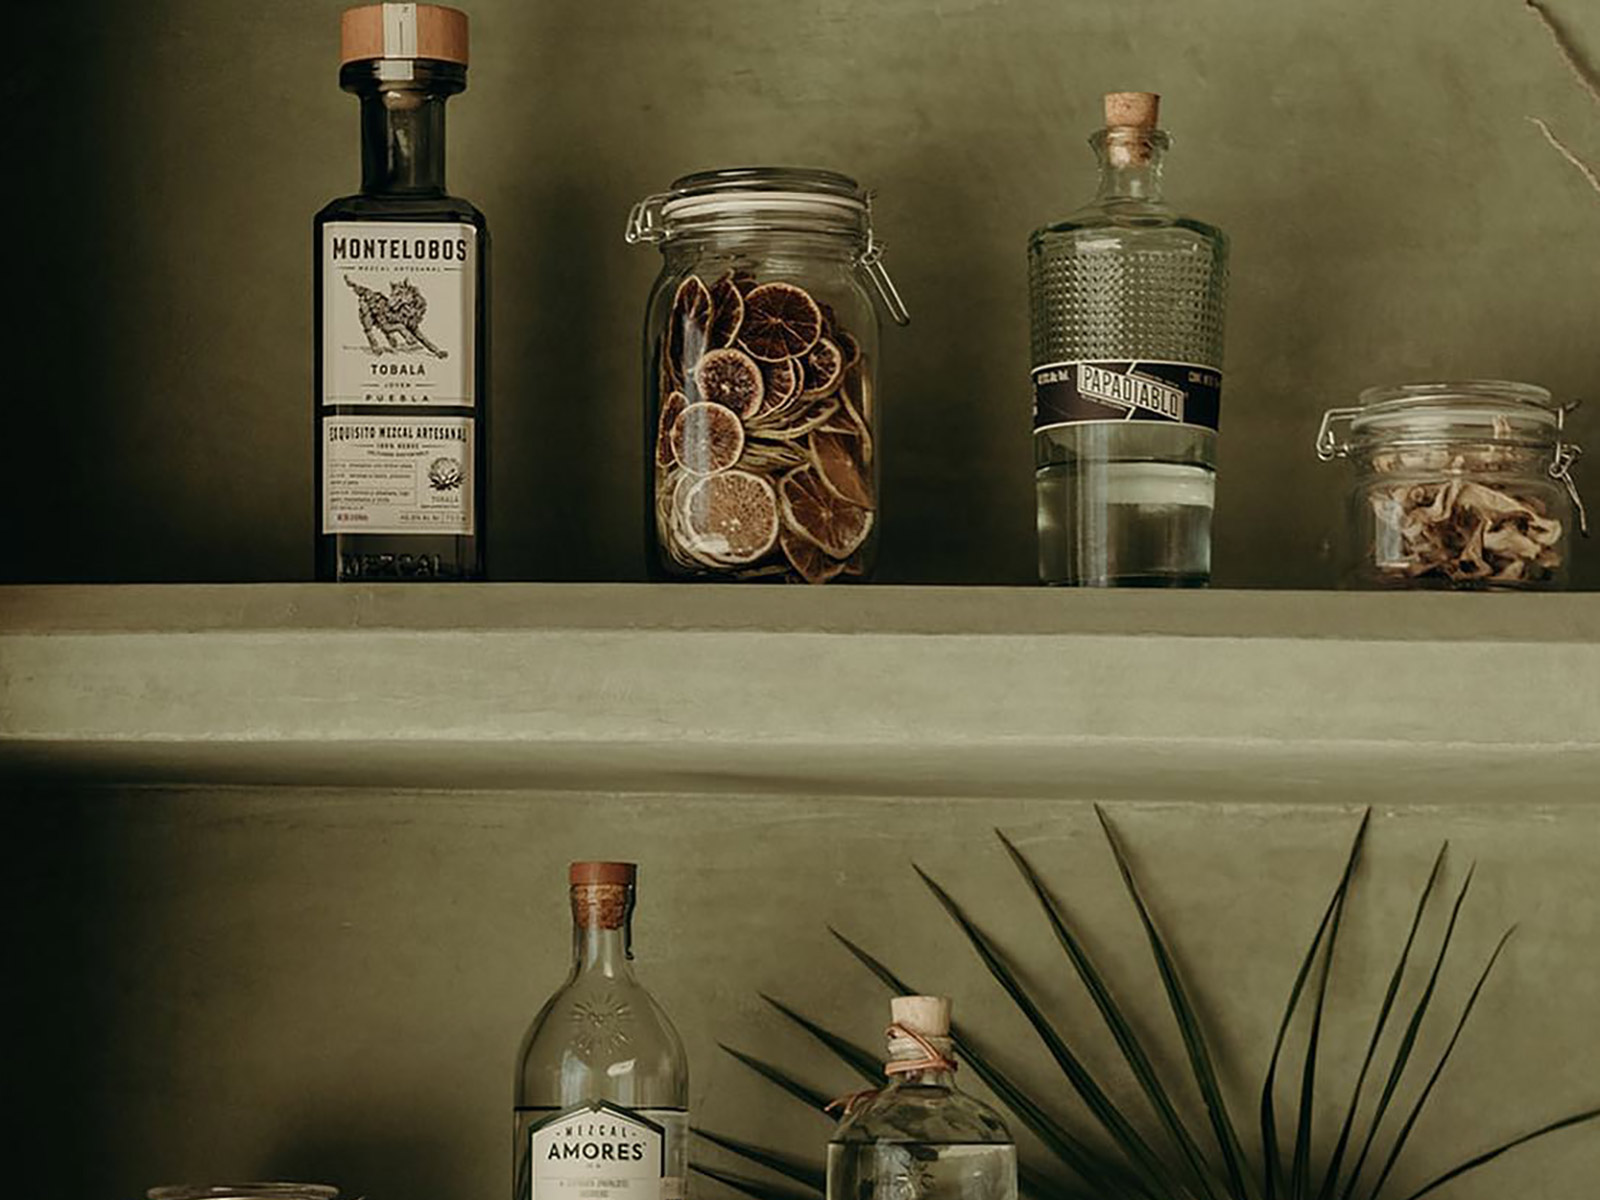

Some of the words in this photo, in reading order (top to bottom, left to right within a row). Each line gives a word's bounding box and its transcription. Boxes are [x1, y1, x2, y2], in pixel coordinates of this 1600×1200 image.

[333, 238, 467, 261] MONTELOBOS
[365, 394, 430, 402] PUEBLA
[1083, 366, 1179, 417] PAPADIABLO
[329, 426, 377, 442] EXQUISITO
[379, 426, 414, 439] MEZCAL
[416, 426, 467, 443] ARTESANAL
[565, 1125, 627, 1138] MEZCAL
[548, 1142, 643, 1161] AMORES
